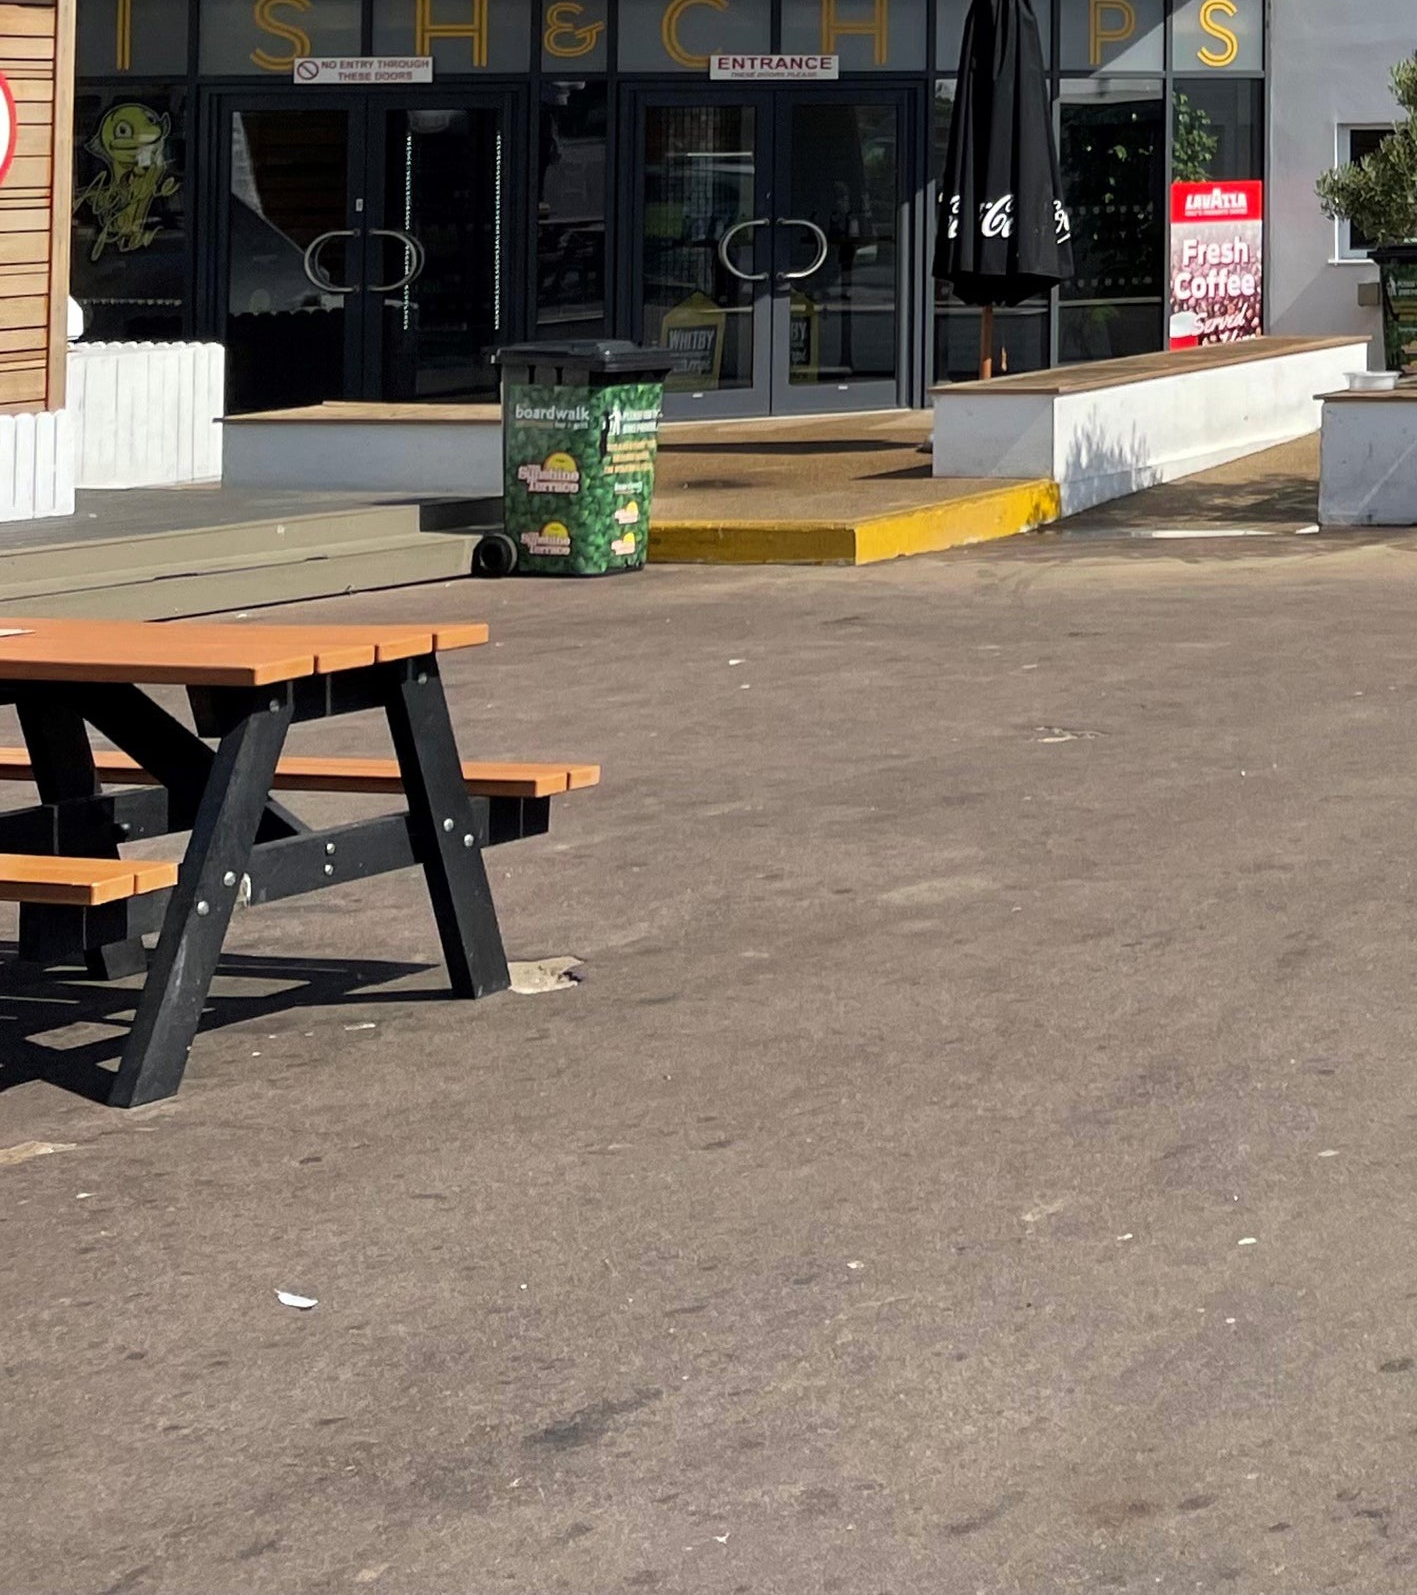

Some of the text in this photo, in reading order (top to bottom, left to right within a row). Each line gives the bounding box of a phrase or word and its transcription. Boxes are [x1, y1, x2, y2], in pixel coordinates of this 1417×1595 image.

[543, 2, 606, 59] &
[321, 59, 430, 70] NO ENTRY THROUGH
[717, 56, 833, 71] ENTRANCE
[337, 71, 414, 81] THESE DOORS
[1184, 188, 1248, 210] LAVAZZA
[1182, 236, 1249, 266] Fresh
[1173, 268, 1256, 301] Coffee
[515, 405, 591, 421] boardwalk
